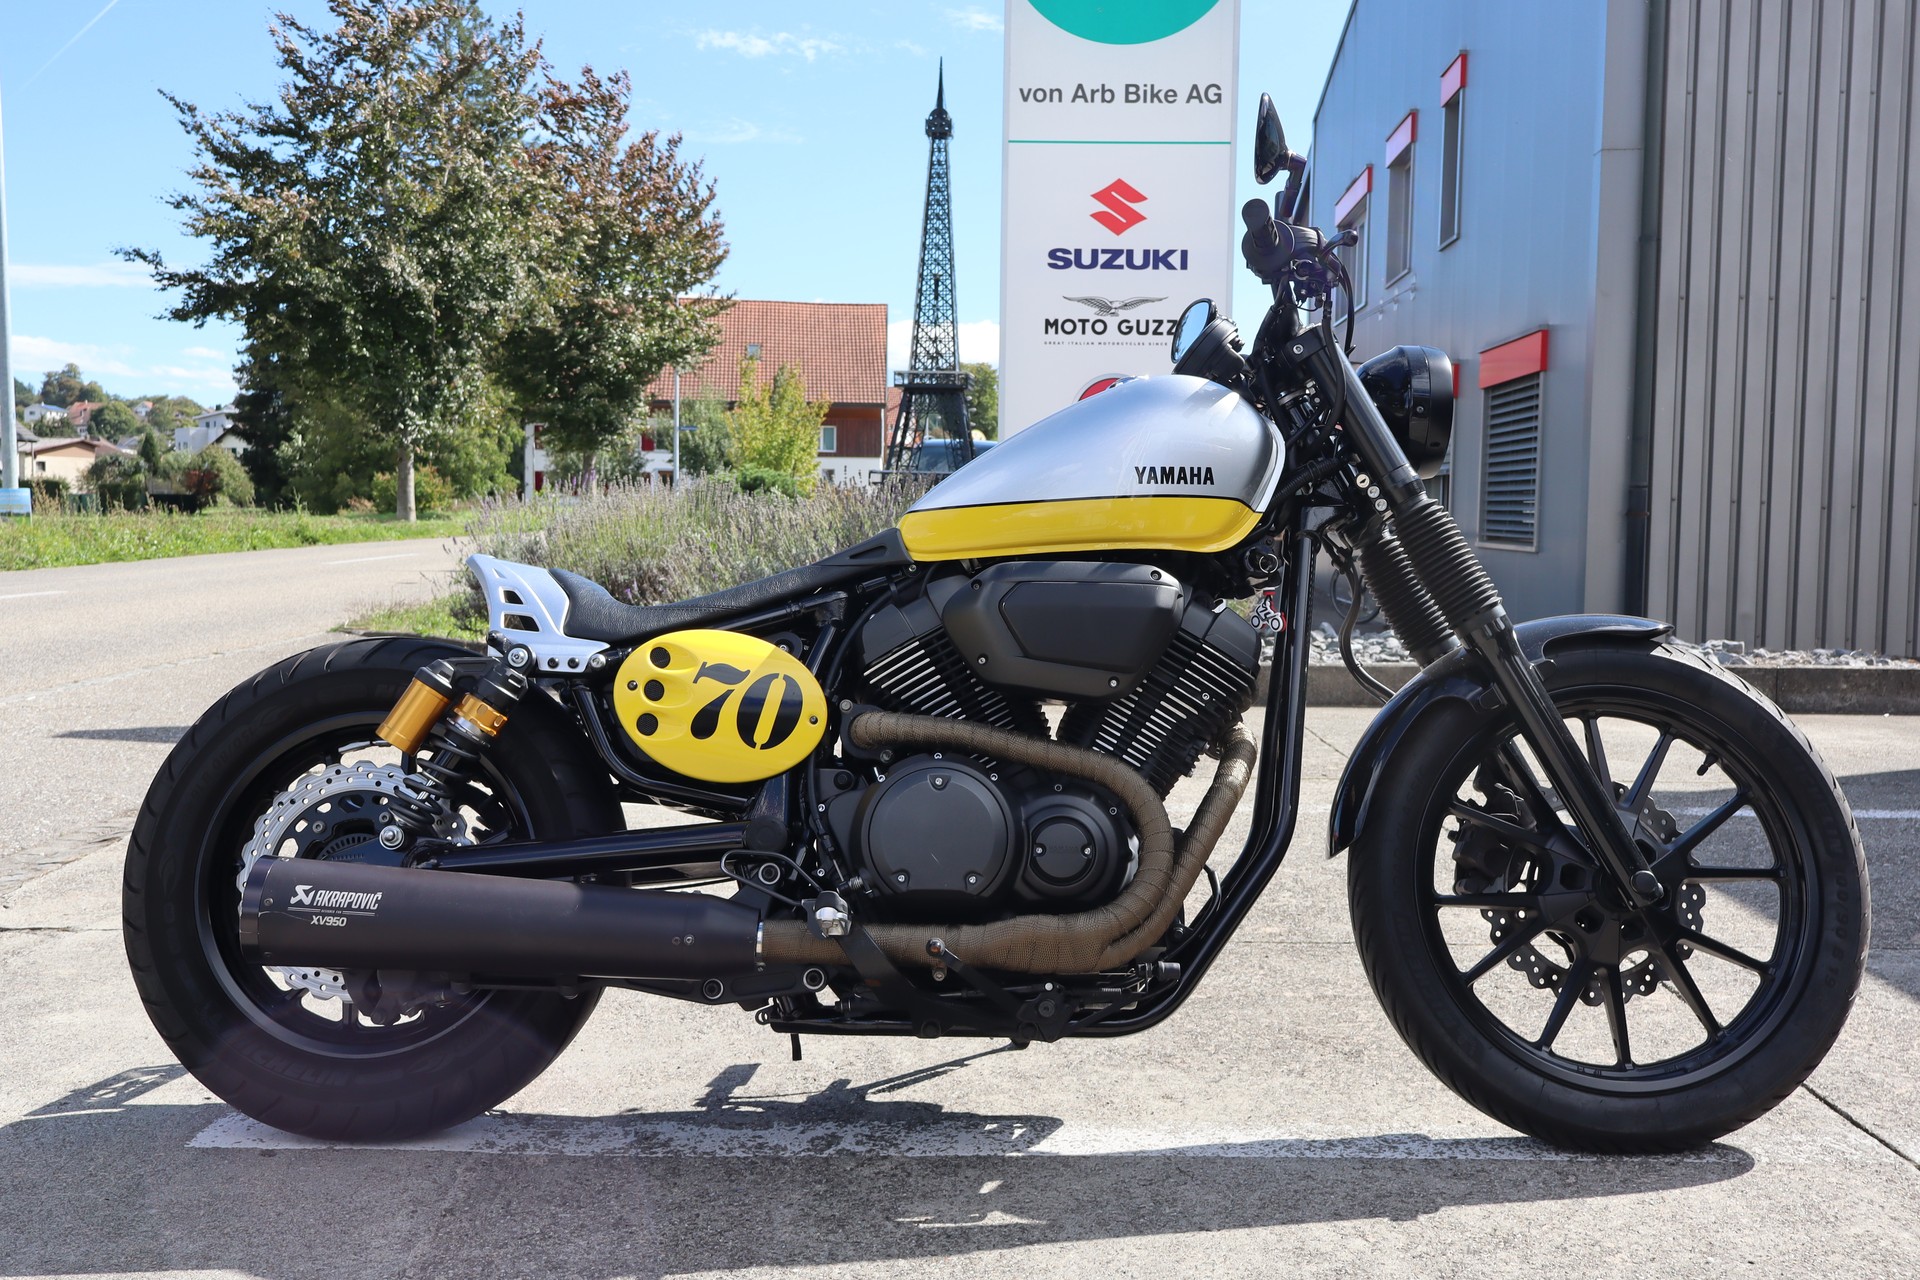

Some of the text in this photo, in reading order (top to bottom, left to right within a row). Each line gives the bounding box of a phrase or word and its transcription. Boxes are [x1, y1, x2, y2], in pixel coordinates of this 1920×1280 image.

[1019, 83, 1222, 104] von Arb Bike AG
[1047, 248, 1188, 270] SUZUKI
[1044, 318, 1178, 336] MOTO GUZZ
[1134, 466, 1215, 485] YAMAHA
[690, 661, 804, 751] 70
[311, 915, 347, 927] XV950
